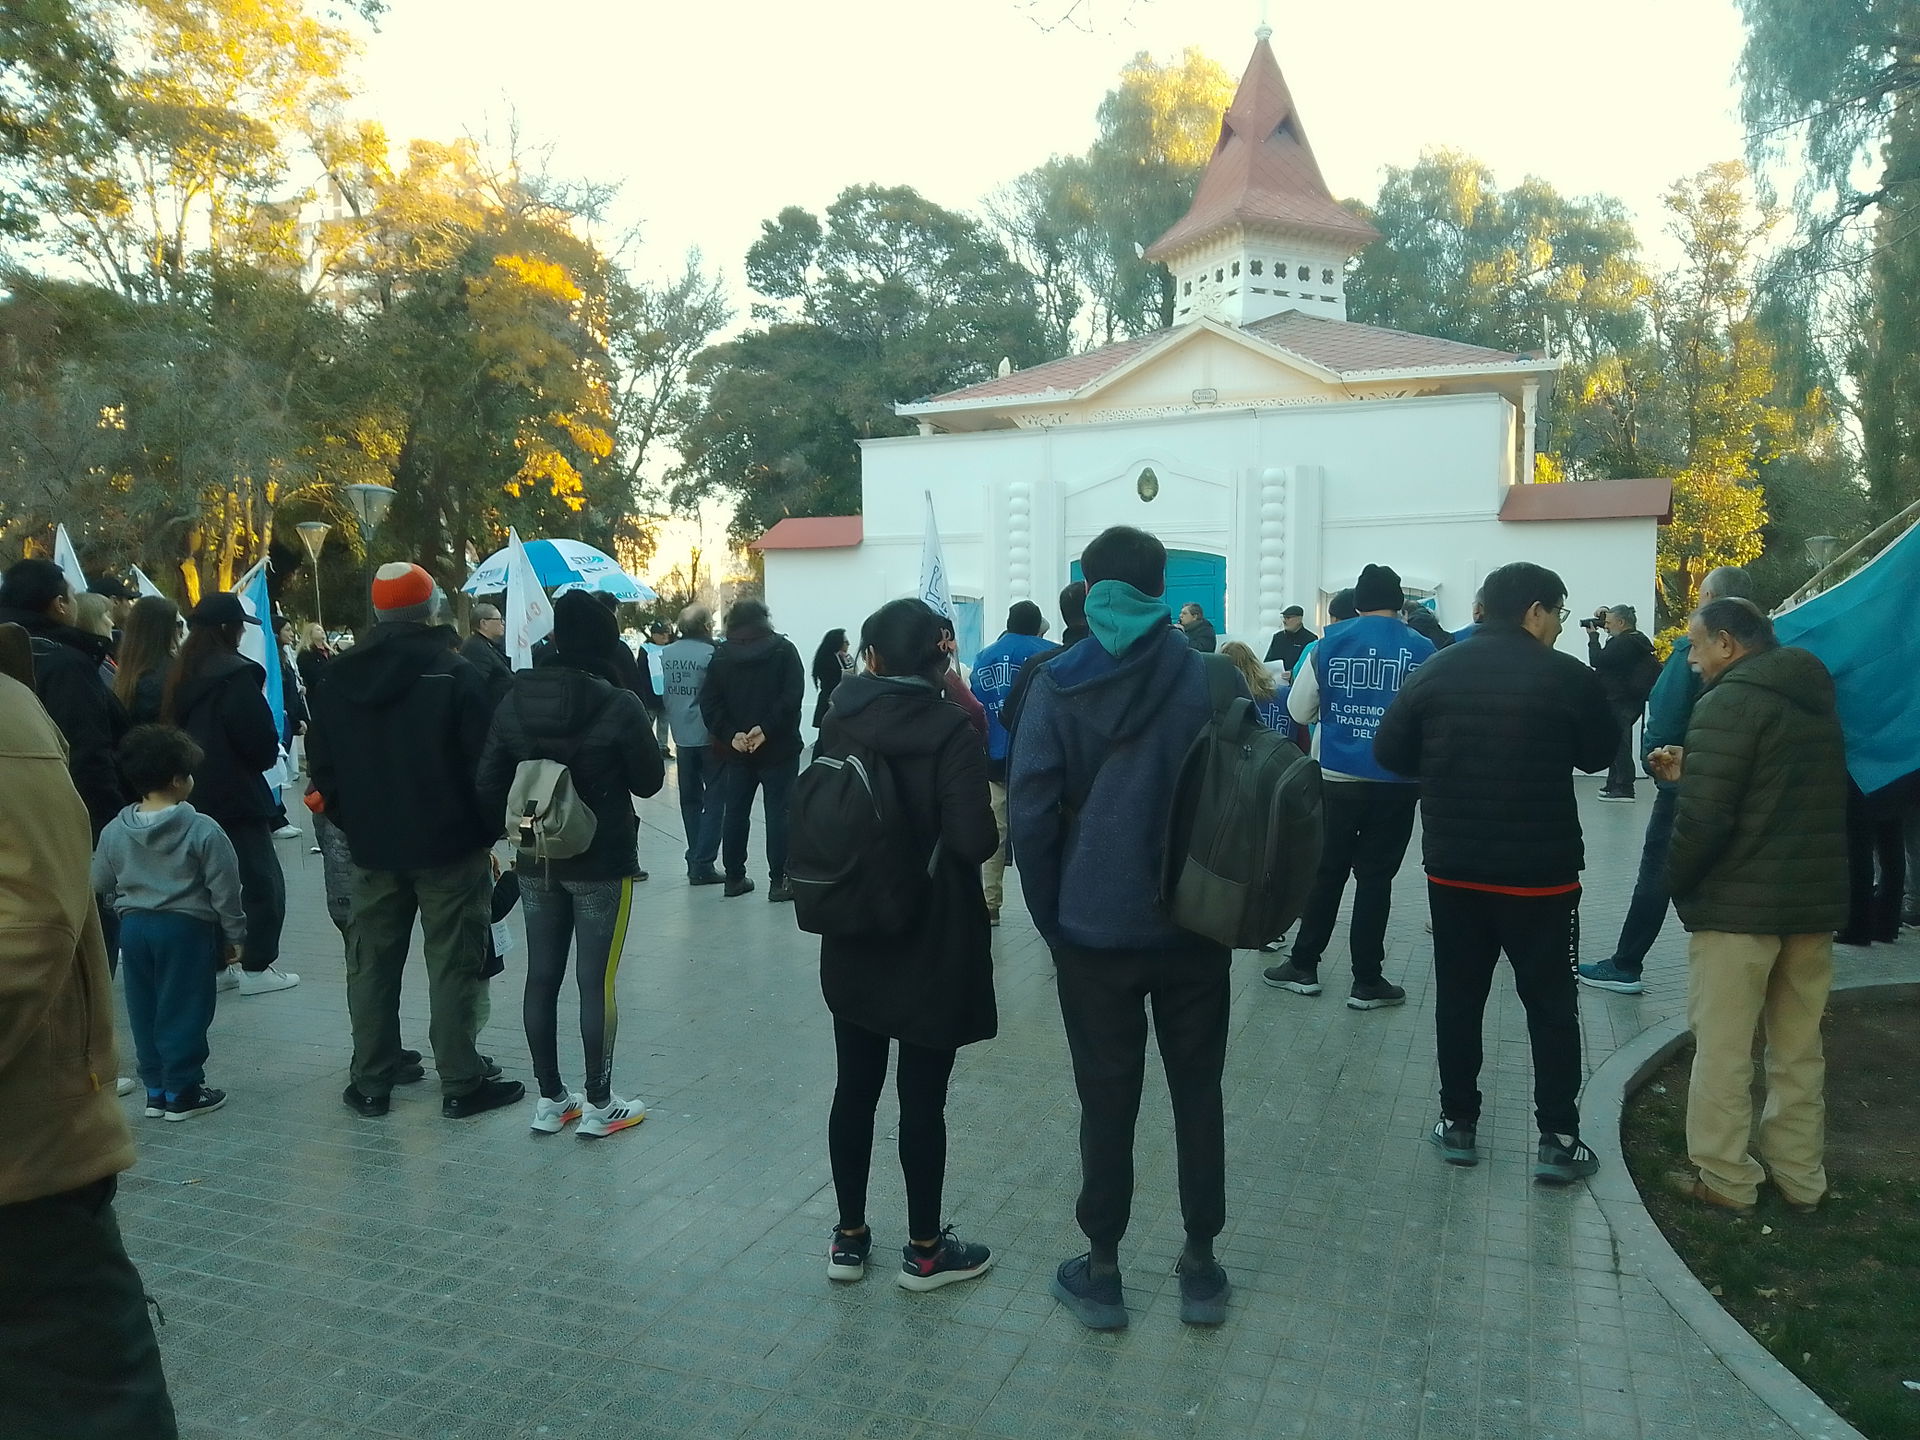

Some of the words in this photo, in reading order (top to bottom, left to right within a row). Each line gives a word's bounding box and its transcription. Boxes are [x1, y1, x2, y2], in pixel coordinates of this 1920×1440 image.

[1330, 702, 1341, 712] EL
[1343, 704, 1385, 717] GREMIO
[1352, 728, 1373, 739] DEL
